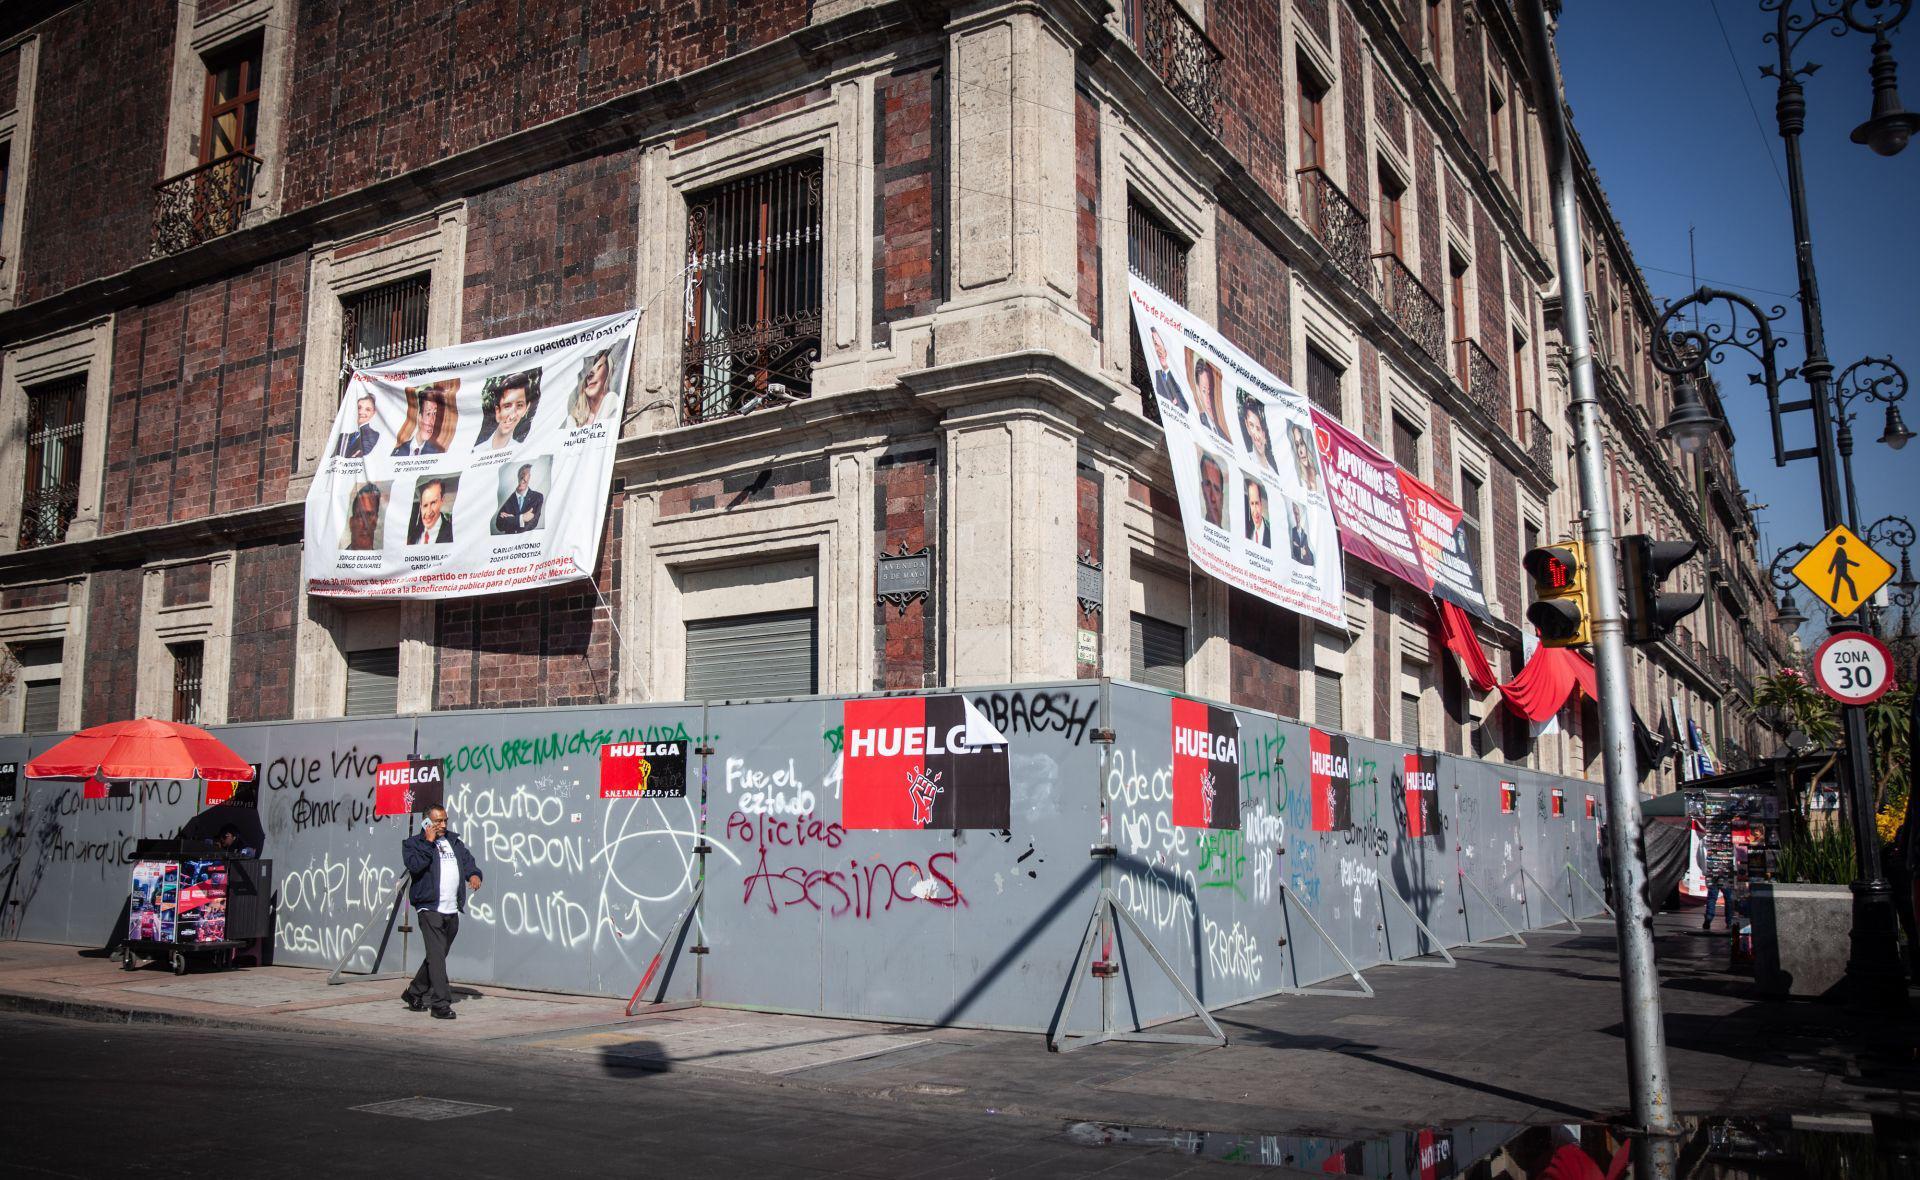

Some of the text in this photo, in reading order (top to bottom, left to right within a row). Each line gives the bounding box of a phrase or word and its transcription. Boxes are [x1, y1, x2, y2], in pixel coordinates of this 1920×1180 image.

[534, 335, 578, 354] opacidad
[580, 331, 595, 343] del
[1184, 327, 1200, 343] miles
[1337, 446, 1384, 496] APOYAMOS
[419, 572, 455, 584] repartido
[469, 568, 496, 579] sueldos
[496, 567, 506, 575] de
[508, 564, 527, 574] estos
[535, 556, 574, 571] personajes
[883, 561, 926, 571] AVENIDA
[411, 583, 457, 593] Beneficencia
[485, 580, 503, 589] para
[512, 574, 537, 587] pueblo
[538, 572, 547, 580] de
[1834, 650, 1870, 664] ZONA
[1837, 665, 1872, 690] 30
[610, 743, 680, 757] HUELGA
[850, 725, 1003, 757] HUELG
[1175, 726, 1238, 764] HUELGA
[379, 765, 441, 786] HUELGA
[726, 757, 770, 794] Fue
[1312, 751, 1349, 779] HUELGA
[1406, 771, 1437, 791] HUELGA
[1254, 846, 1273, 904] HDP
